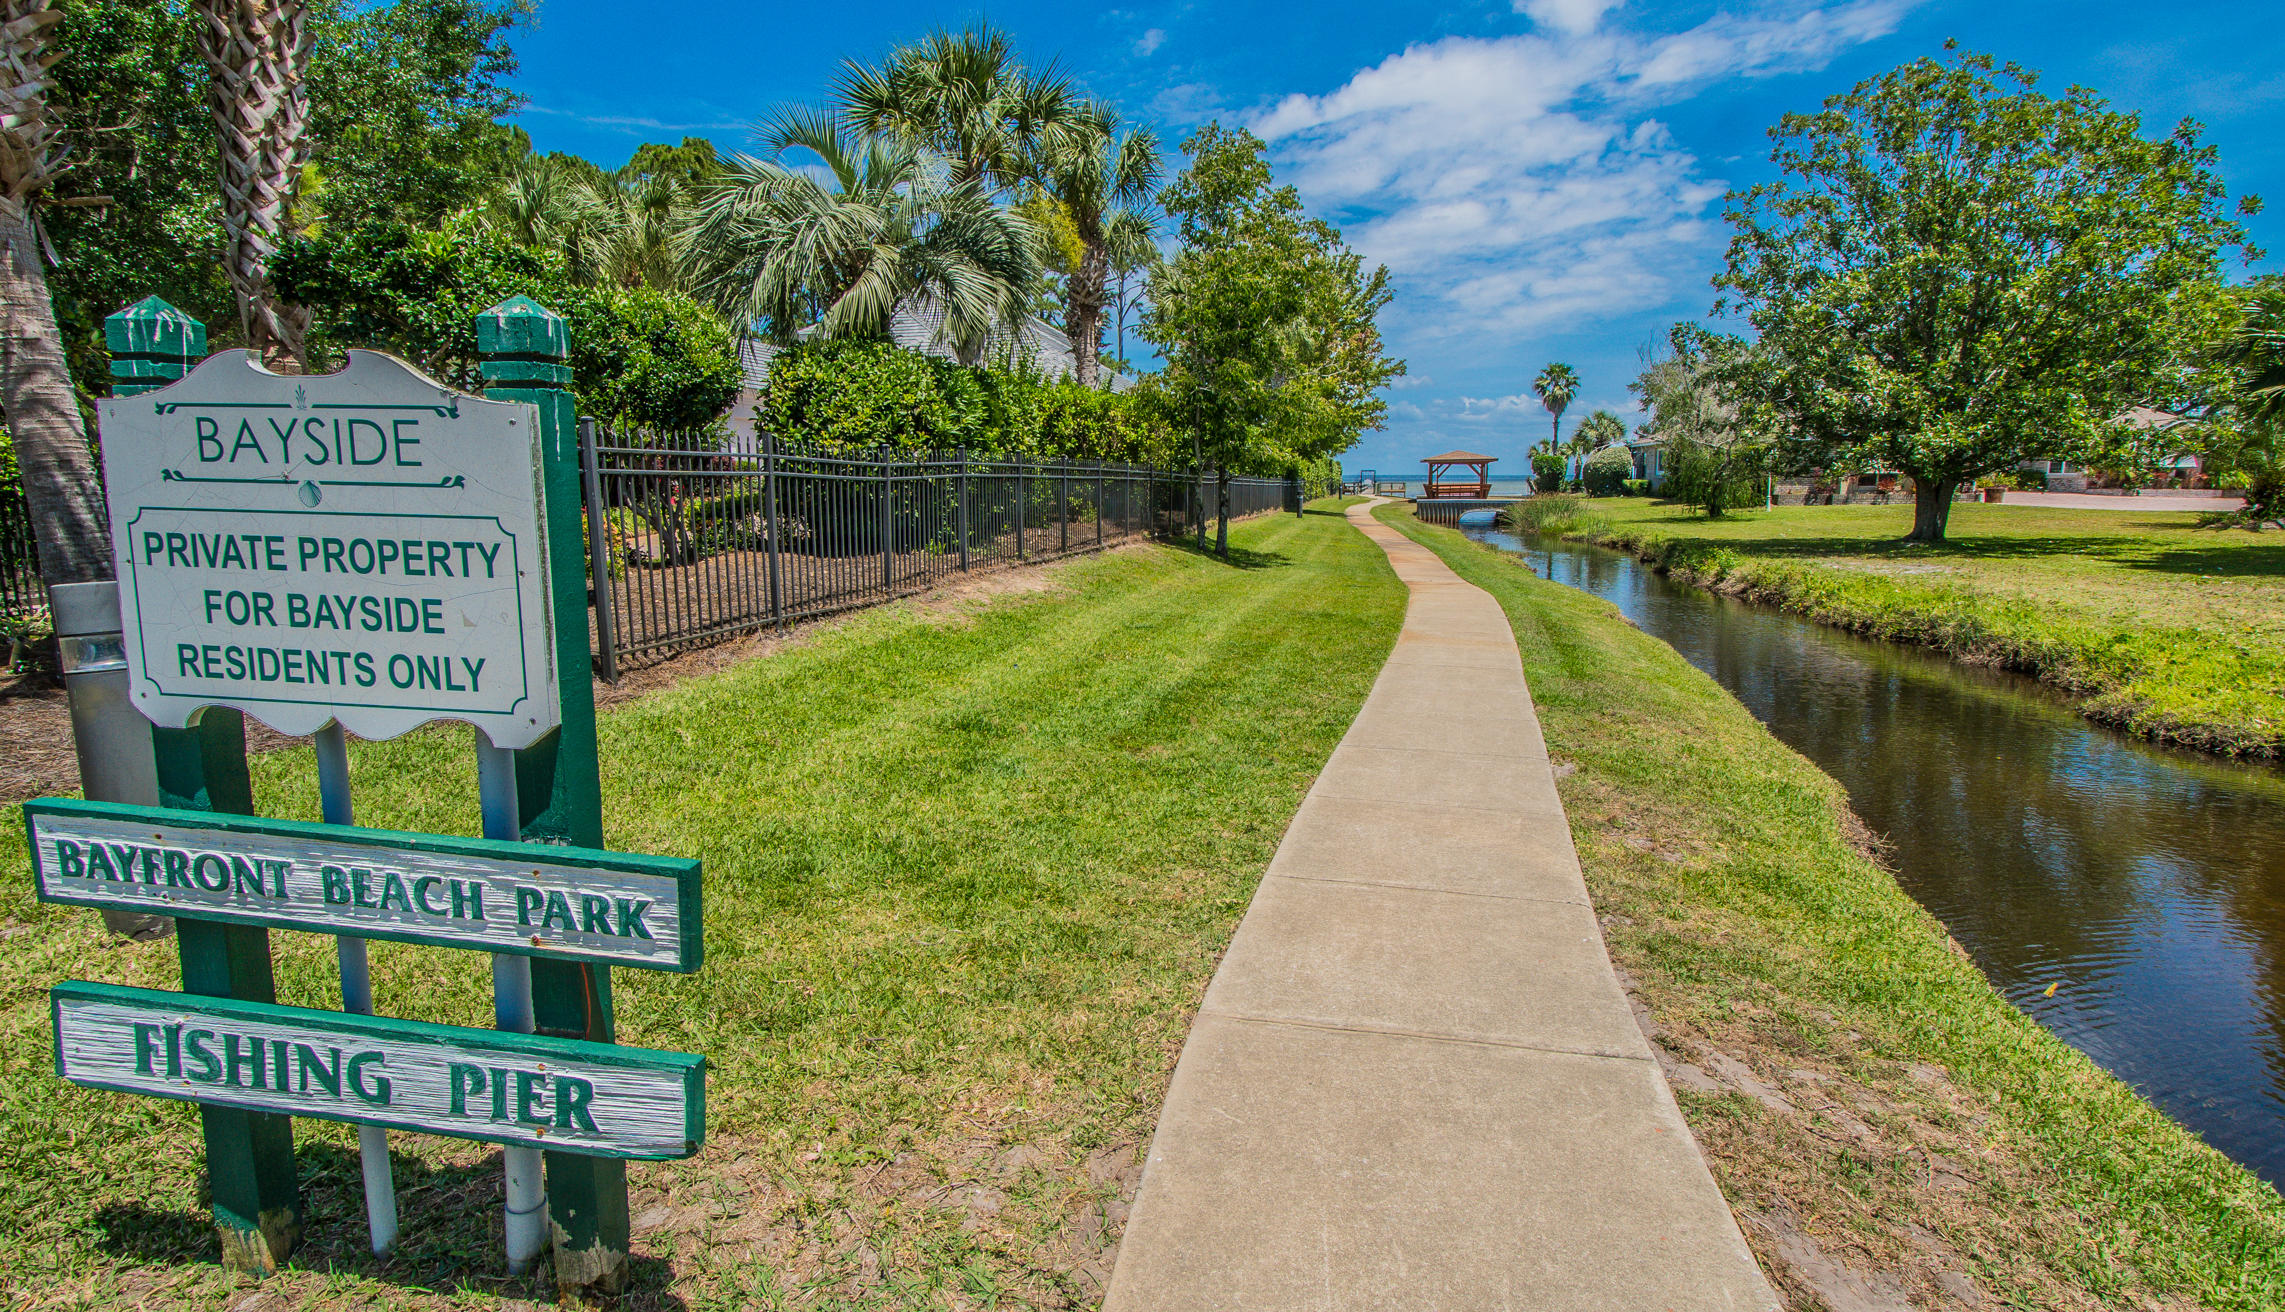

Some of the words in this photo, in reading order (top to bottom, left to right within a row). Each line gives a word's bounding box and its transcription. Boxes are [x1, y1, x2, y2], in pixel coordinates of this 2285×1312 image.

[195, 416, 423, 467] BAYSIDE
[143, 531, 288, 571] PRIVATE
[298, 536, 501, 579] PROPERTY
[203, 590, 278, 628] FOR
[287, 593, 446, 634] BAYSIDE
[177, 643, 377, 688] RESIDENTS
[388, 653, 486, 692] ONLY
[56, 839, 291, 899] BAYFRONT
[322, 865, 485, 921] BEACH
[515, 885, 654, 940] PARK
[133, 1021, 392, 1105] FISHING
[449, 1061, 599, 1132] PIER
